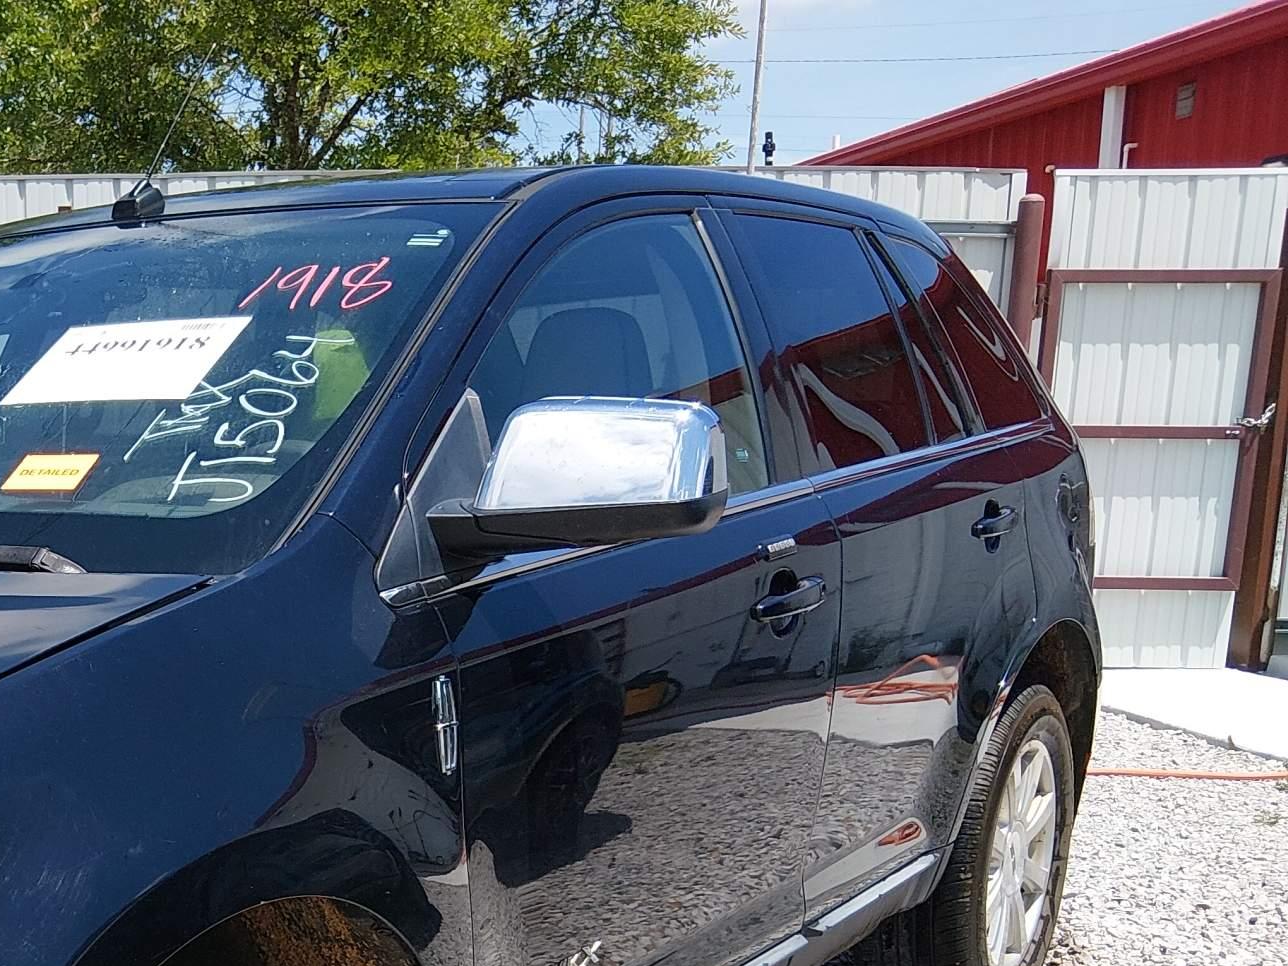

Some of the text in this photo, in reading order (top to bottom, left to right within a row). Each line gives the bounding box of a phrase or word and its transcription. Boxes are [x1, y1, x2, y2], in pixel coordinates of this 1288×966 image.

[238, 256, 393, 311] 1918
[65, 336, 211, 356] 44991918
[18, 468, 80, 476] DETAILED
